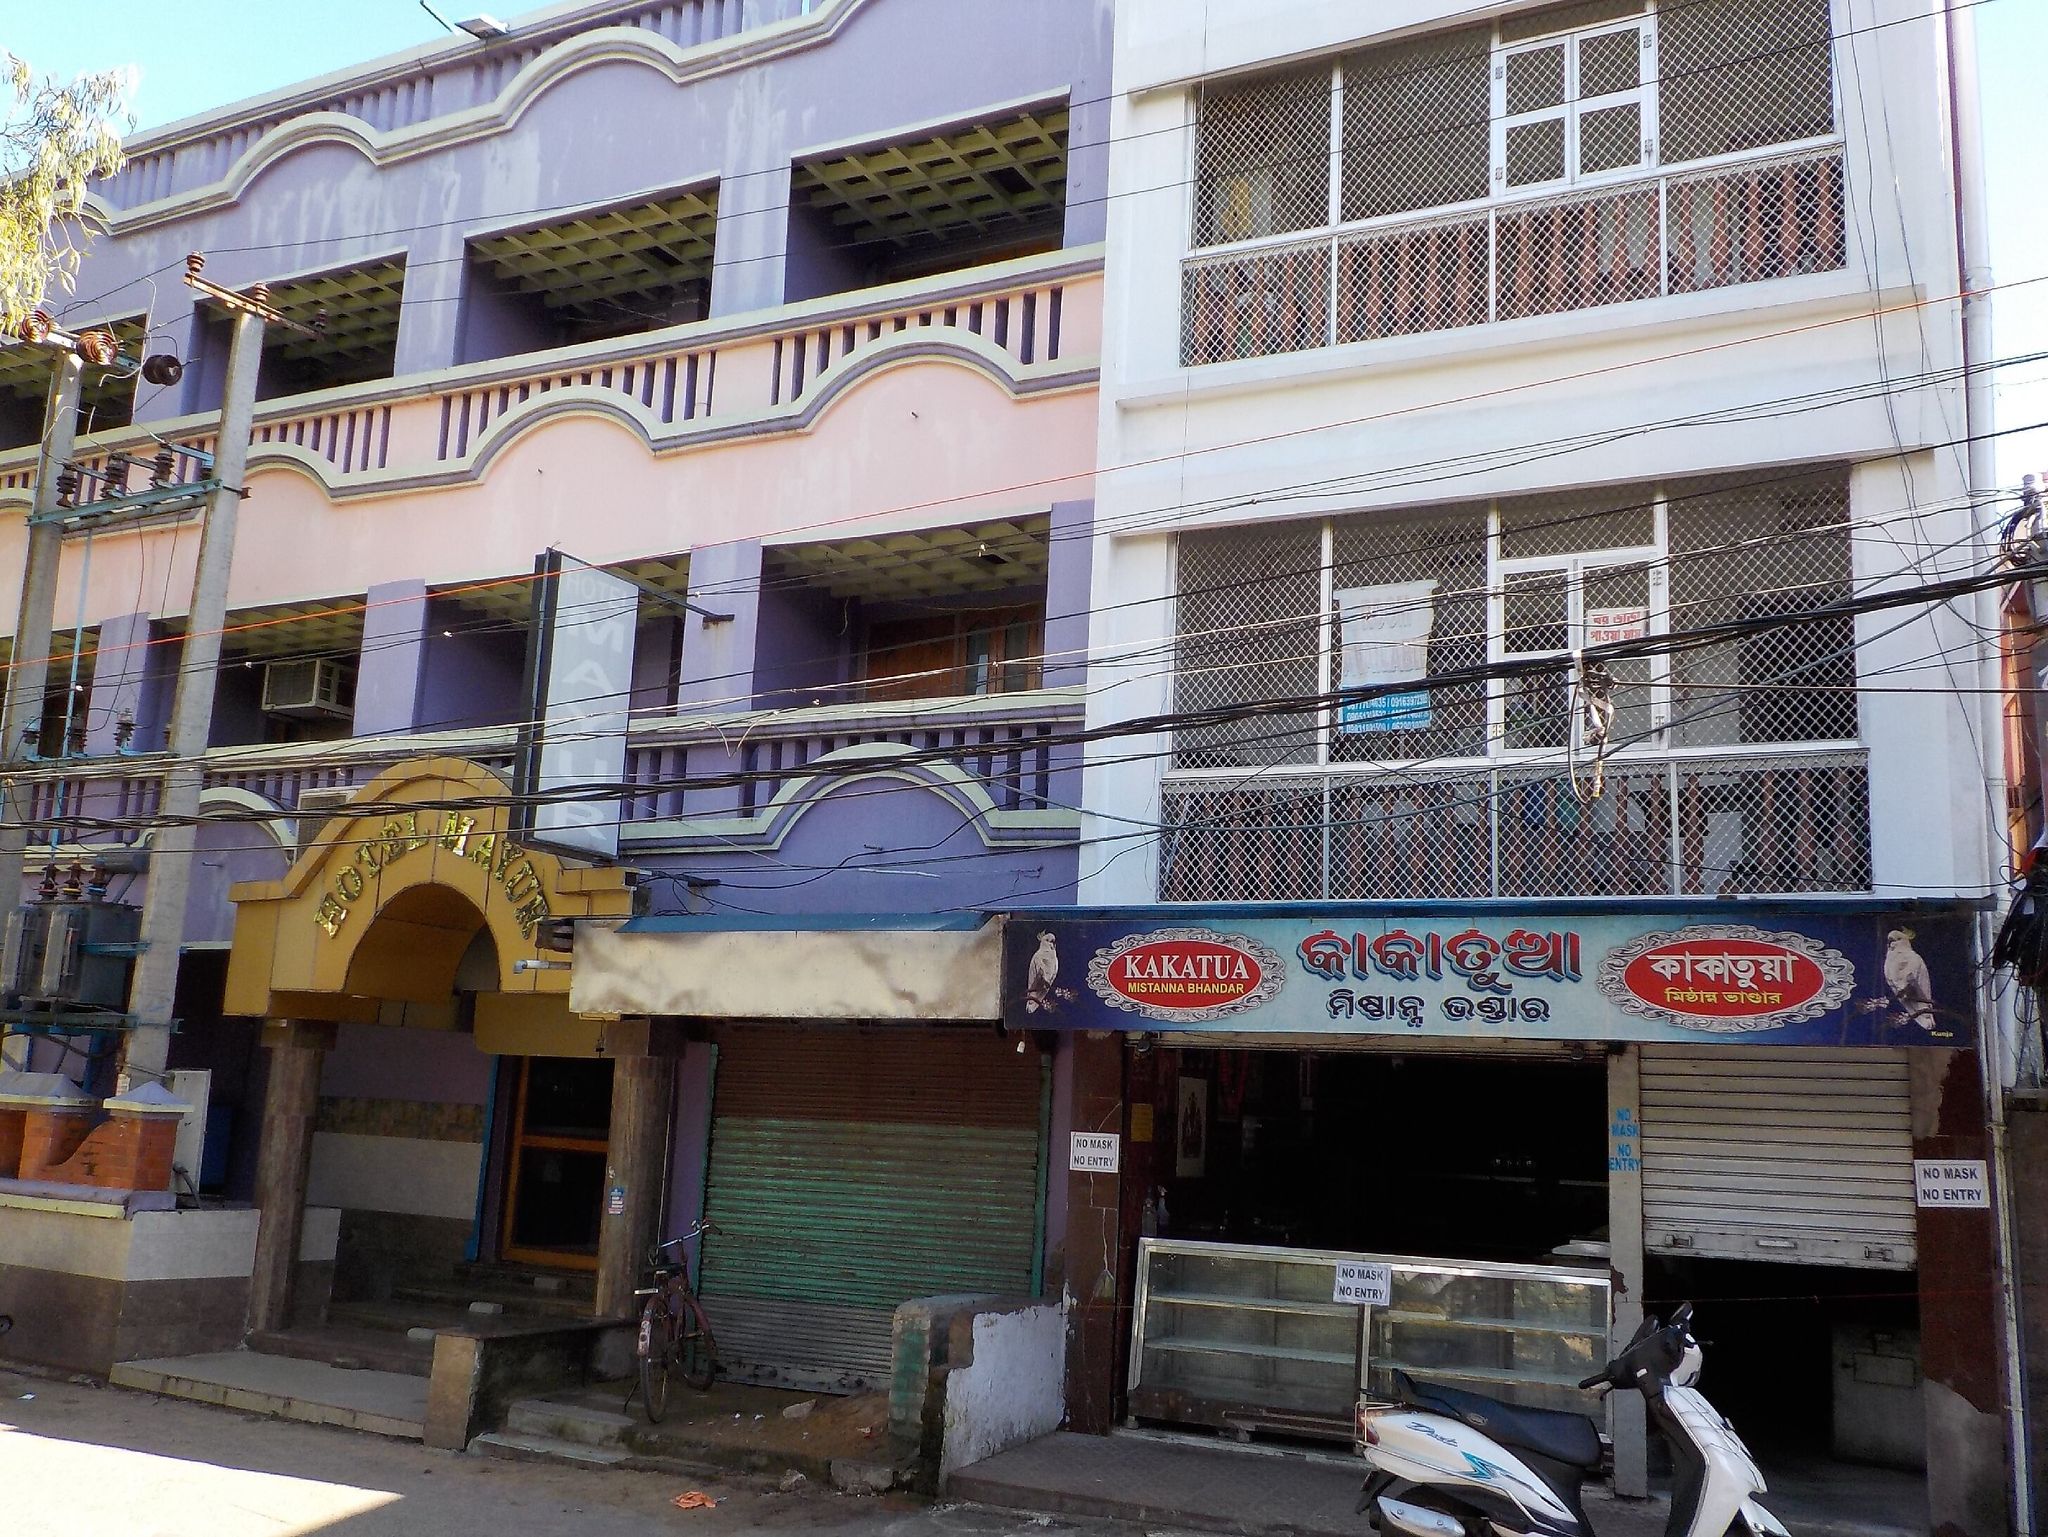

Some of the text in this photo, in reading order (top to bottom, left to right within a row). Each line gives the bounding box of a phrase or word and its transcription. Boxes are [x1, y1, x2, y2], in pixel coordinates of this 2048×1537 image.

[313, 810, 550, 940] HOTEL MAYUR
[1124, 954, 1250, 980] KAKATUA
[1298, 928, 1583, 994] କାକାତୁଆ
[1646, 950, 1800, 991] কাকাতুয়া
[1128, 982, 1244, 994] MISTANNA BHANDAR
[1440, 996, 1552, 1023] ଭଣ୍ଡାର
[1616, 1108, 1631, 1121] NO
[1611, 1124, 1639, 1137] MASK
[1076, 1138, 1113, 1150] NO MASK
[1617, 1143, 1631, 1157] NO
[1074, 1156, 1114, 1167] NO ENTRY
[1609, 1157, 1641, 1171] ENTRY
[1923, 1167, 1978, 1179] NO MASK
[1923, 1189, 1982, 1200] NO ENTRY
[1342, 1268, 1384, 1281] NO MASK
[1339, 1286, 1385, 1300] NO ENTRY
